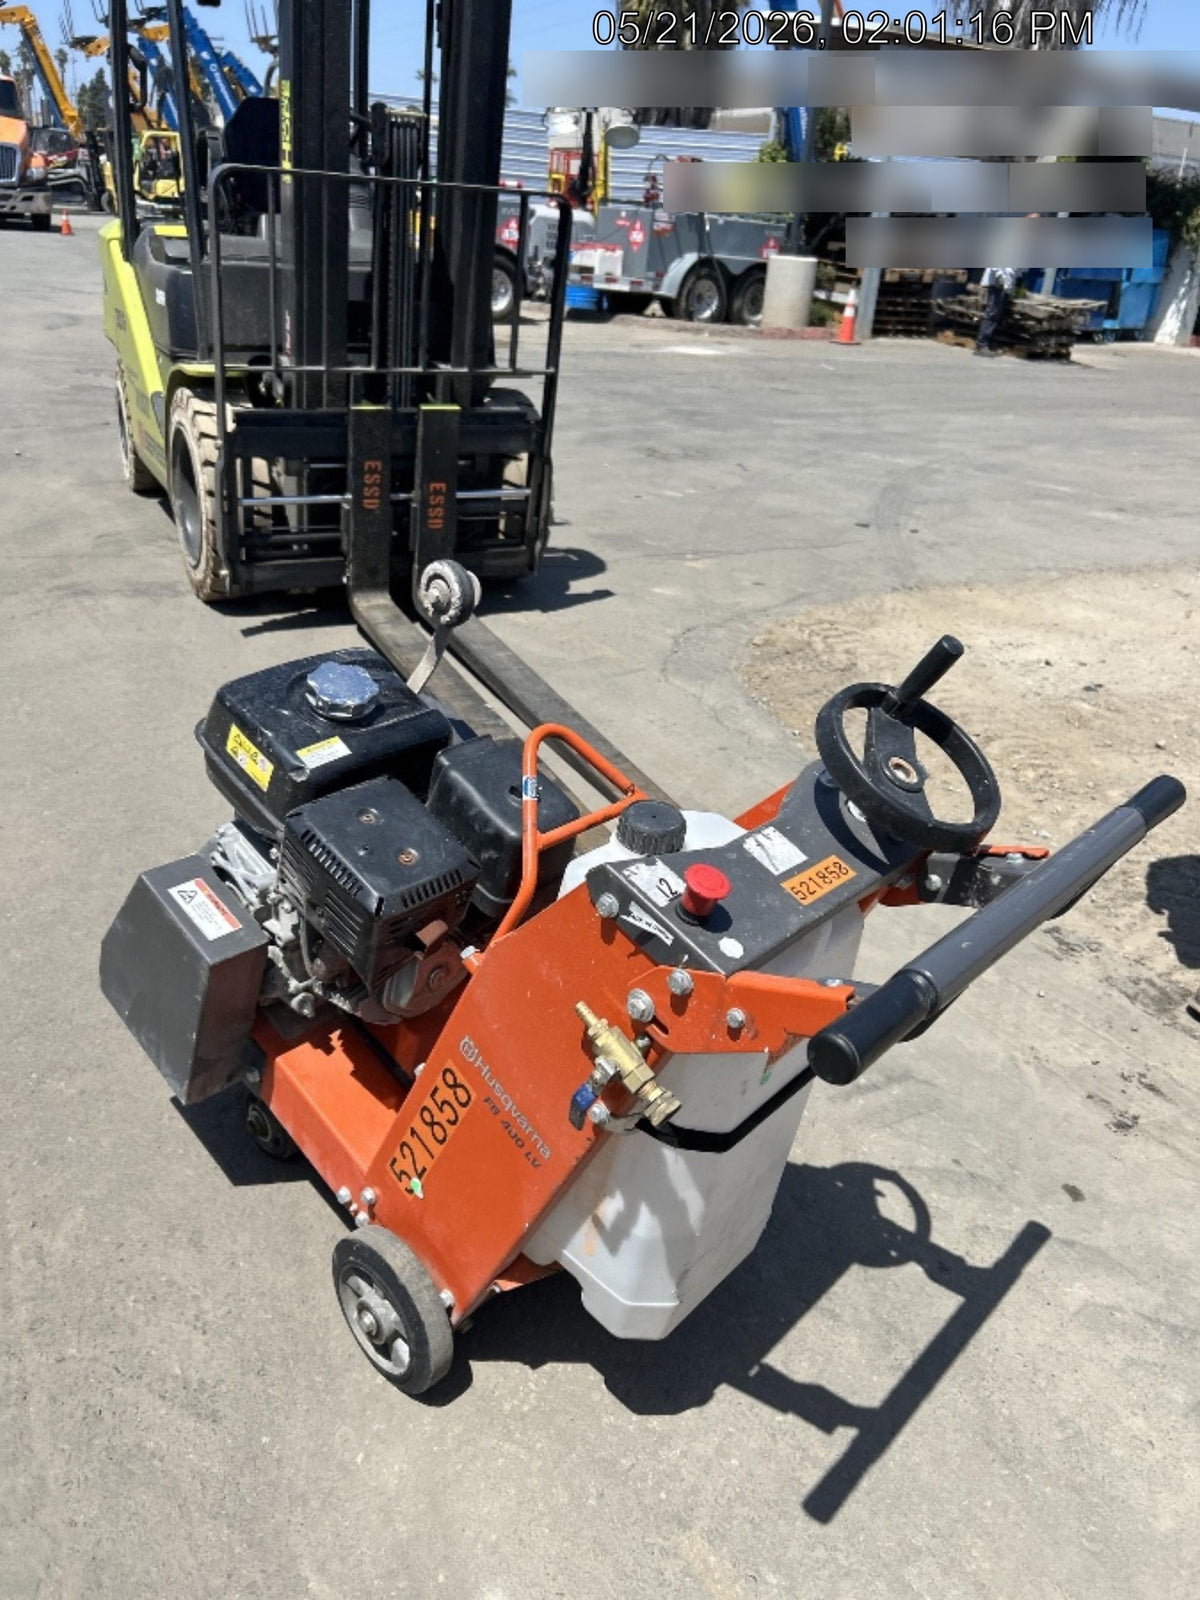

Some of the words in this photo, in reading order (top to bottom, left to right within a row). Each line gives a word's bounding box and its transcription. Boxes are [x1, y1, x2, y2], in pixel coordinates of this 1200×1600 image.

[790, 861, 849, 901] 521858
[388, 1067, 472, 1196] 521858
[474, 1055, 552, 1160] Husqvarna
